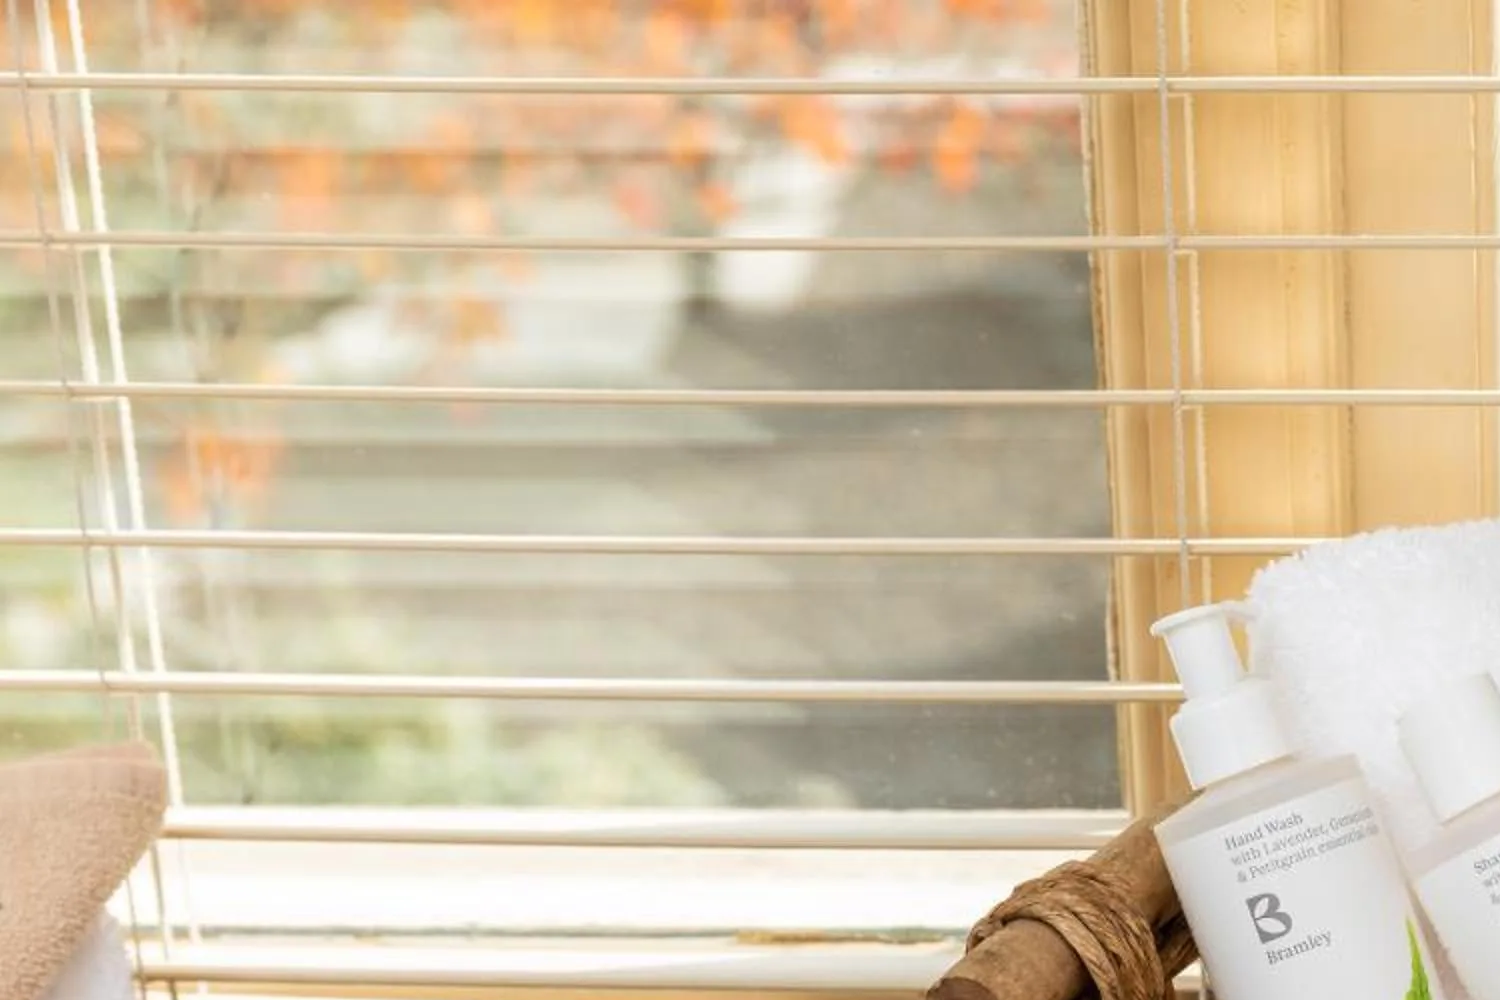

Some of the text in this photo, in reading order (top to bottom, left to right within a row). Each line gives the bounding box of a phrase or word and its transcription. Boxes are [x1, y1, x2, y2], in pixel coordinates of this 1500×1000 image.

[1225, 811, 1304, 851] Hand Wash
[1231, 844, 1262, 867] with
[1245, 892, 1293, 945] B
[1266, 929, 1332, 966] Bramley
